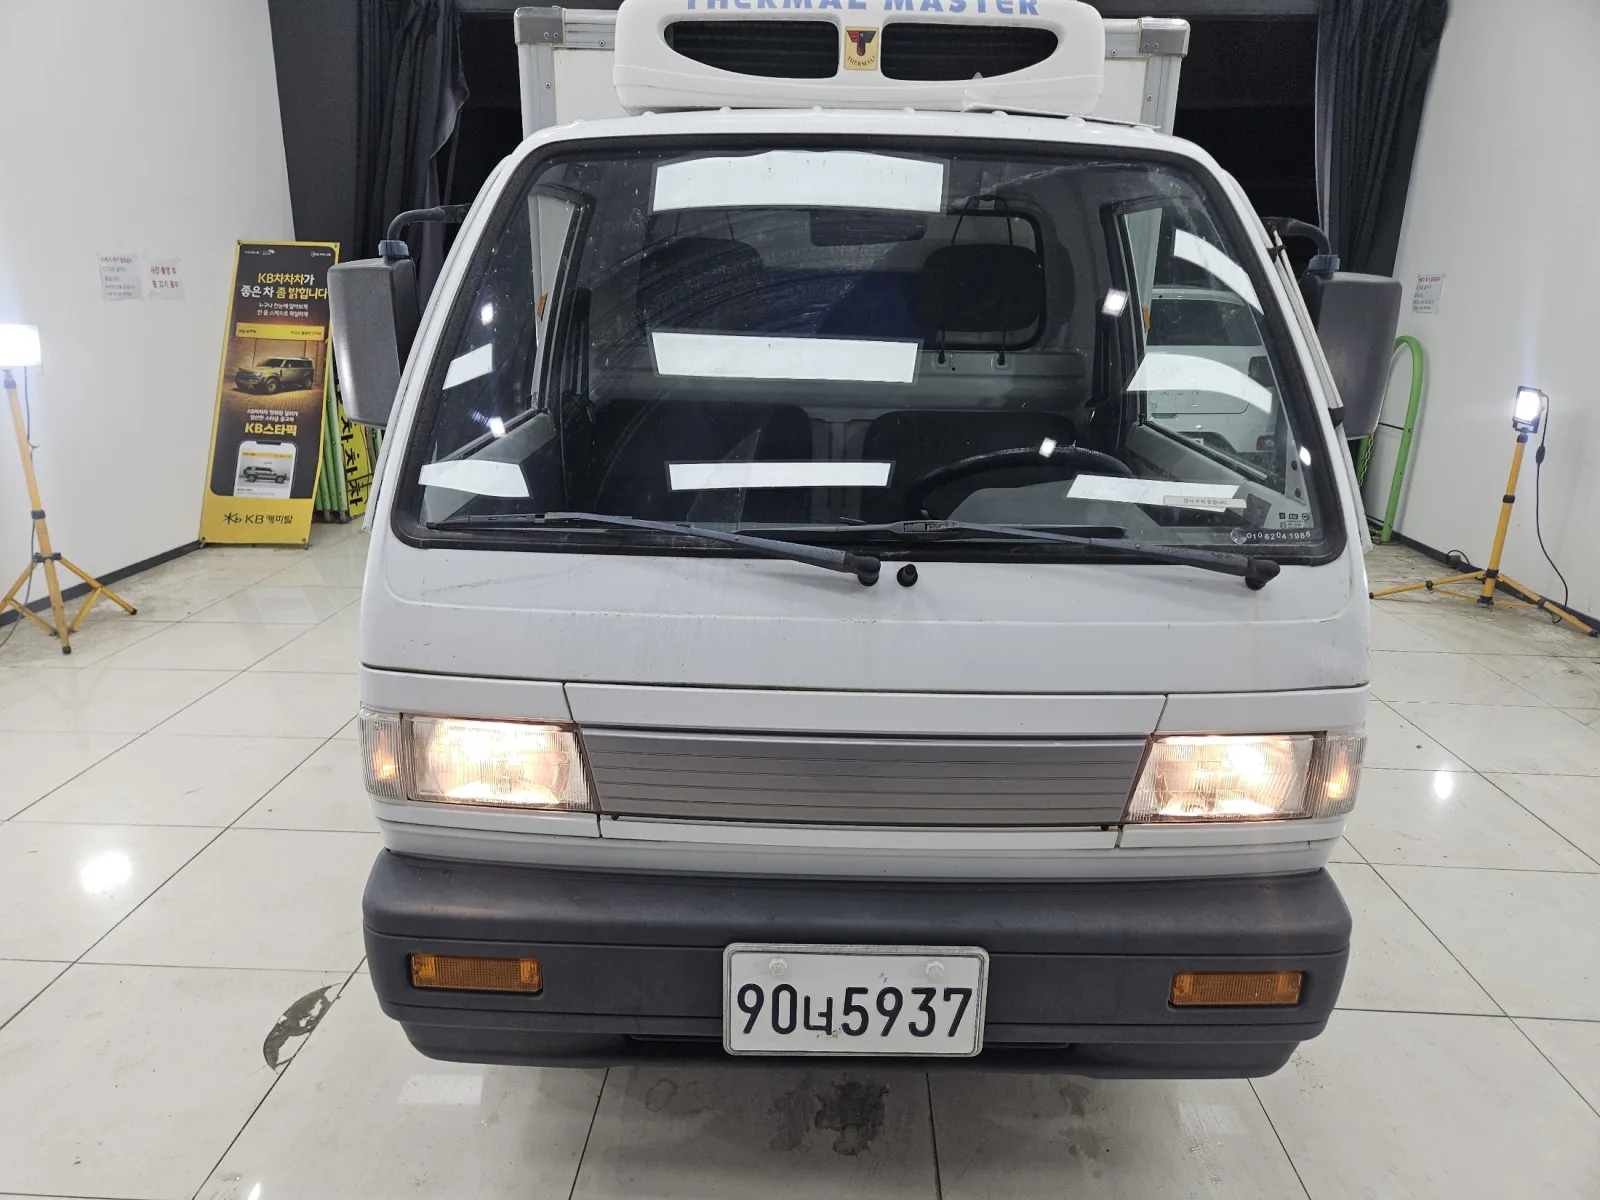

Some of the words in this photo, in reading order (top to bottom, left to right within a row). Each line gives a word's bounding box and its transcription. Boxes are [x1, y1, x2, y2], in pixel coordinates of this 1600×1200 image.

[258, 272, 315, 286] KB차차차가
[240, 285, 261, 298] 좋은
[263, 286, 275, 298] 차
[276, 287, 287, 299] 좀
[288, 287, 328, 300] 밝힙니다
[245, 422, 298, 436] KB스타픽
[245, 514, 265, 525] KB
[266, 514, 294, 525] 캐피탈
[737, 983, 973, 1038] 90너5937
